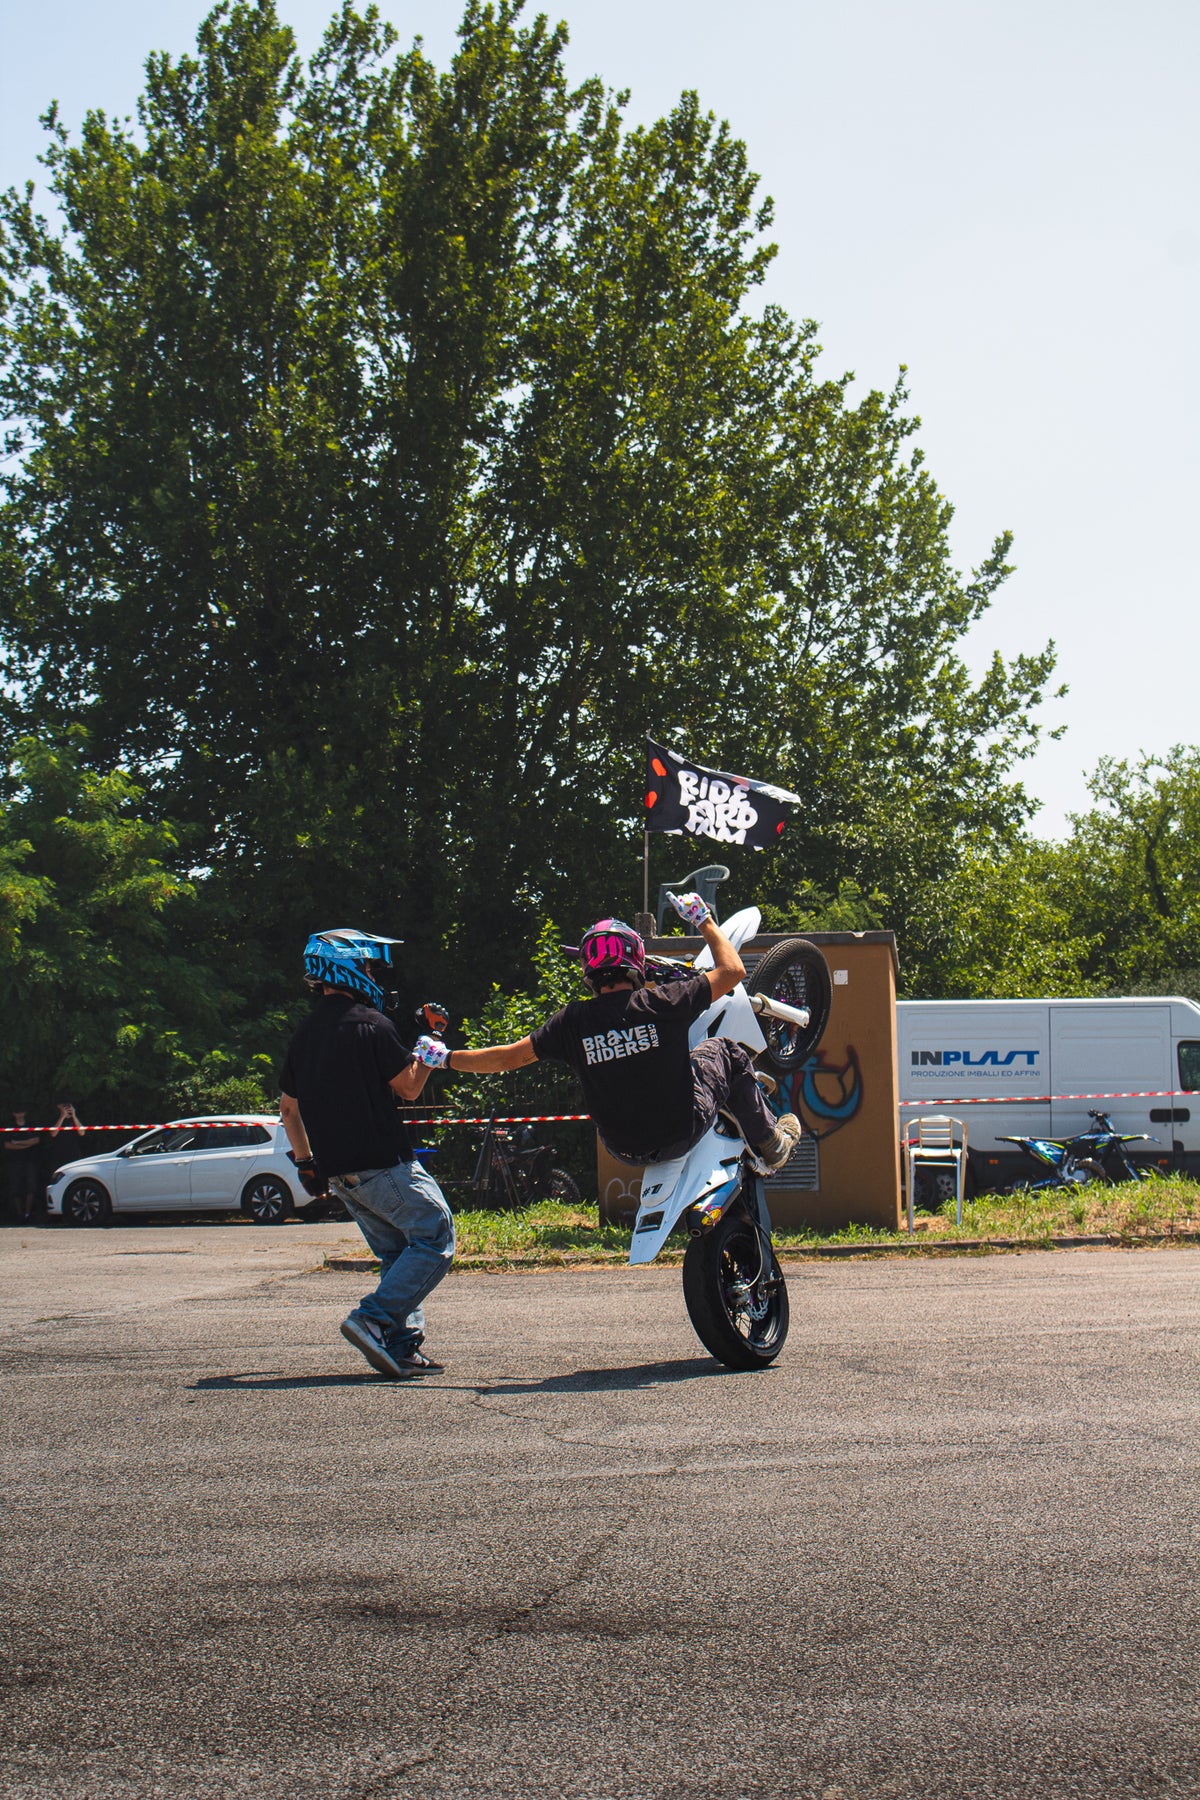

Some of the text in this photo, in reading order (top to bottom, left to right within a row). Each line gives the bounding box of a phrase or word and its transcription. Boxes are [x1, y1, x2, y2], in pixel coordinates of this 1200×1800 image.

[677, 770, 750, 807] RIDE
[647, 1023, 660, 1048] CREW
[585, 1038, 651, 1066] RIDERS
[911, 1050, 1040, 1066] INPLAST
[911, 1070, 966, 1078] PRODUZIONE
[967, 1070, 1000, 1078] IMBALLI
[1001, 1070, 1013, 1078] ED
